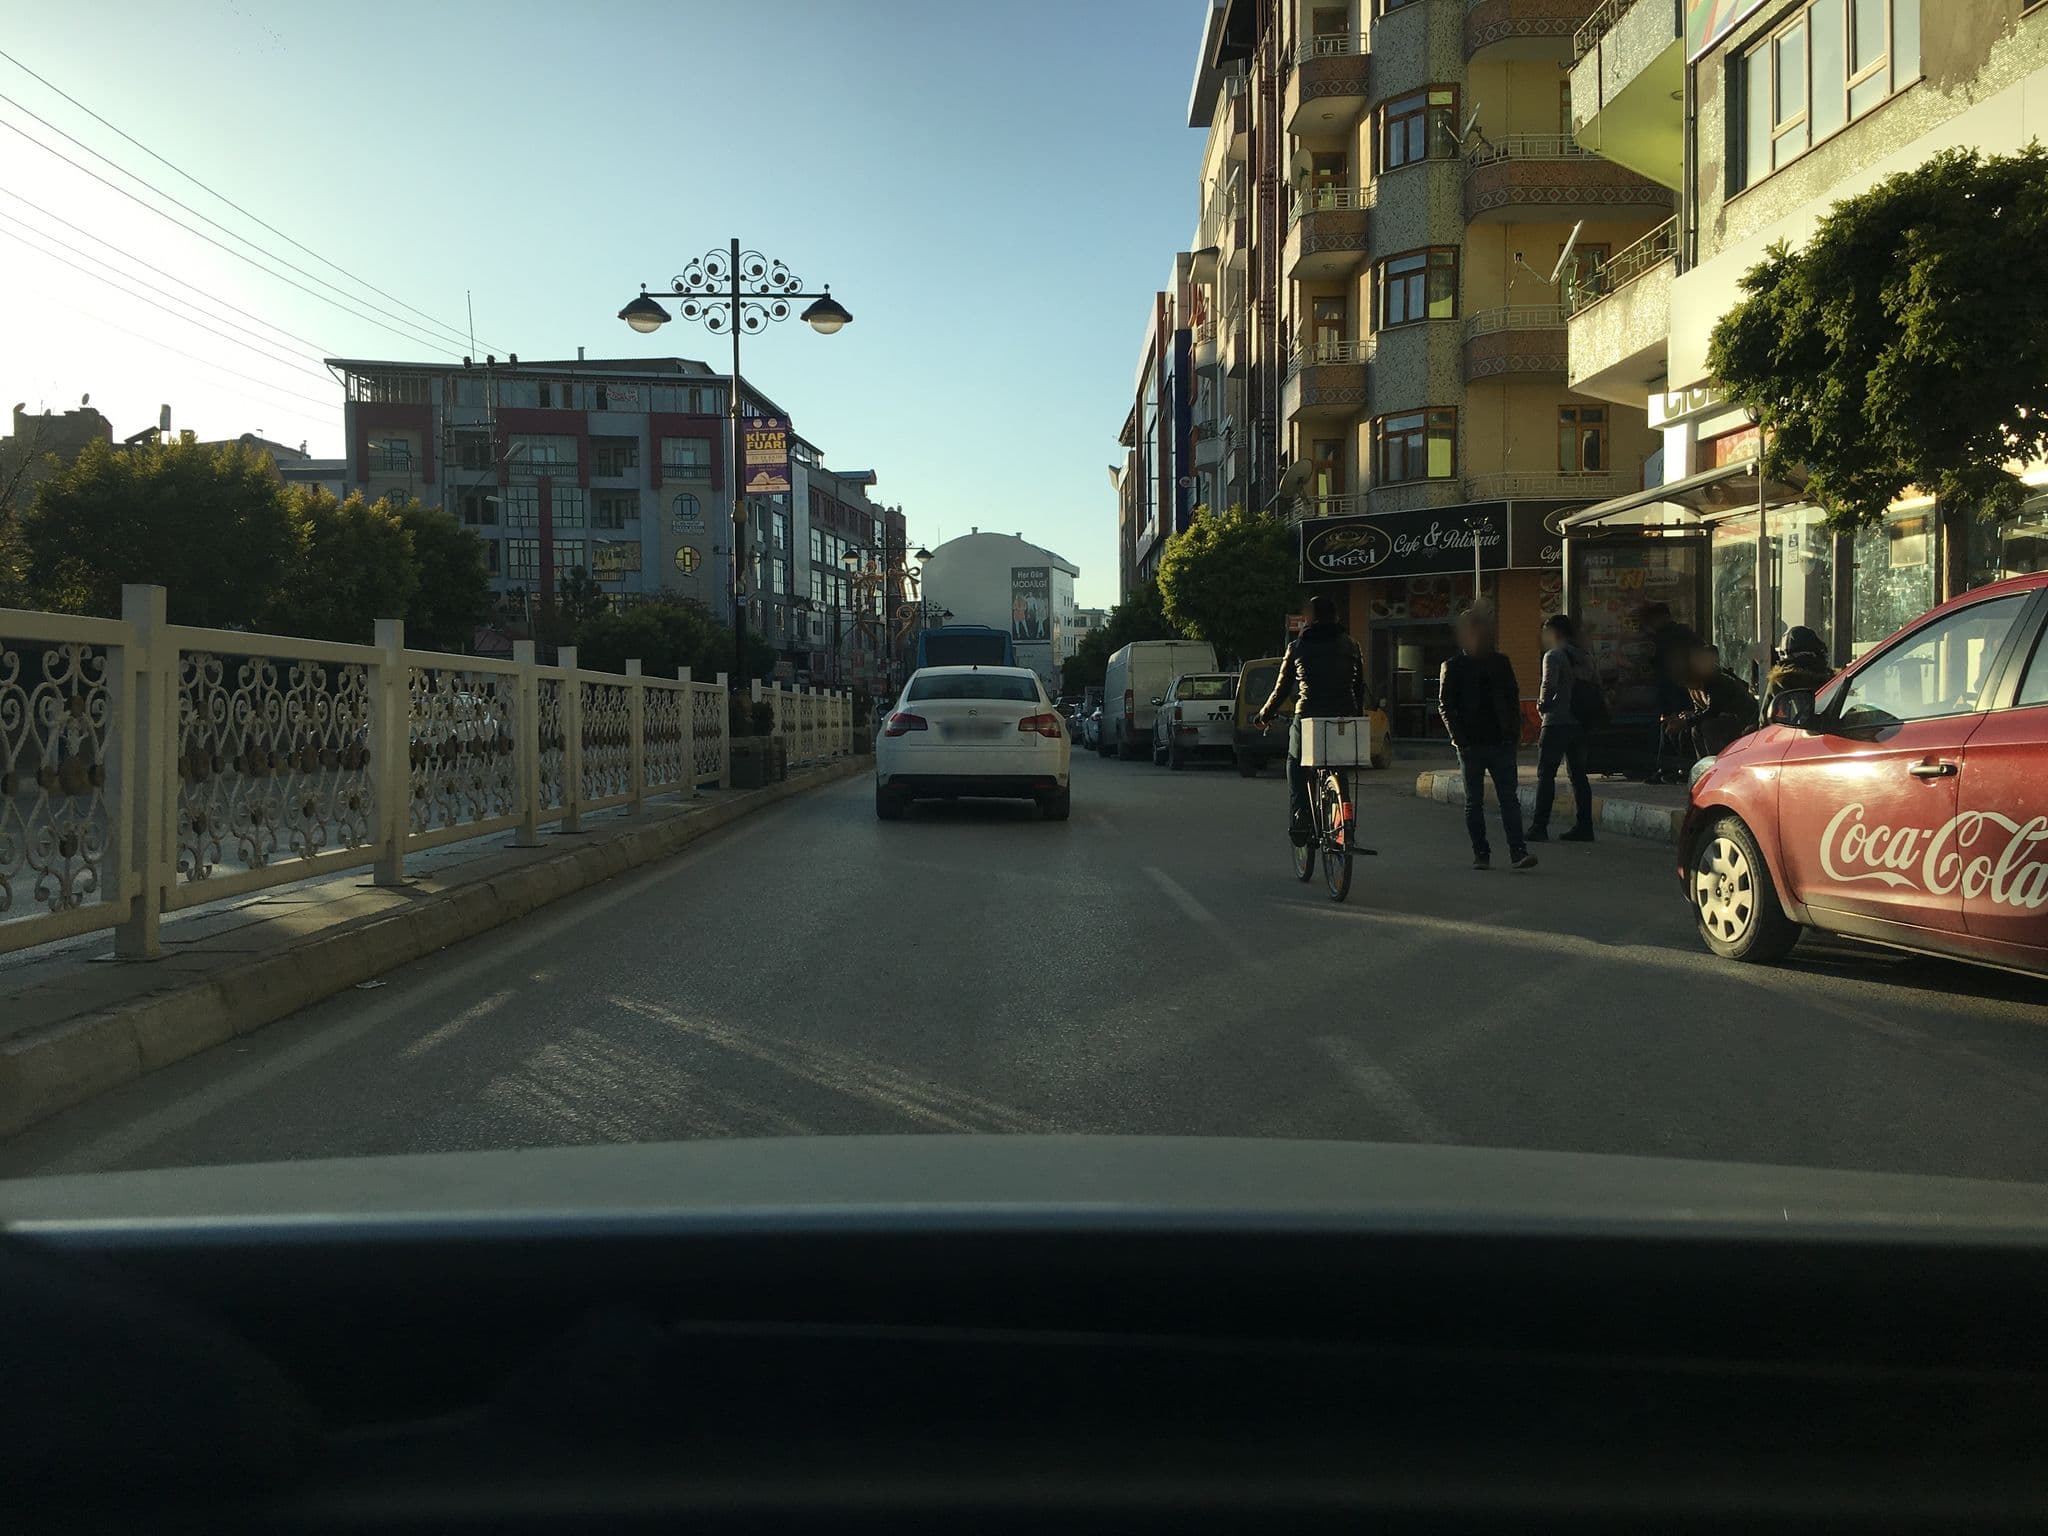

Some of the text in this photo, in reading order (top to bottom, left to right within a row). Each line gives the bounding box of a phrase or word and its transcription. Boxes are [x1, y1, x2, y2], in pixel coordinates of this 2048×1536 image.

[746, 432, 786, 442] KİTAP
[746, 441, 787, 450] FUARI
[1393, 521, 1500, 558] Cafe & Patiserie
[1819, 802, 2048, 910] Coca-Cola
